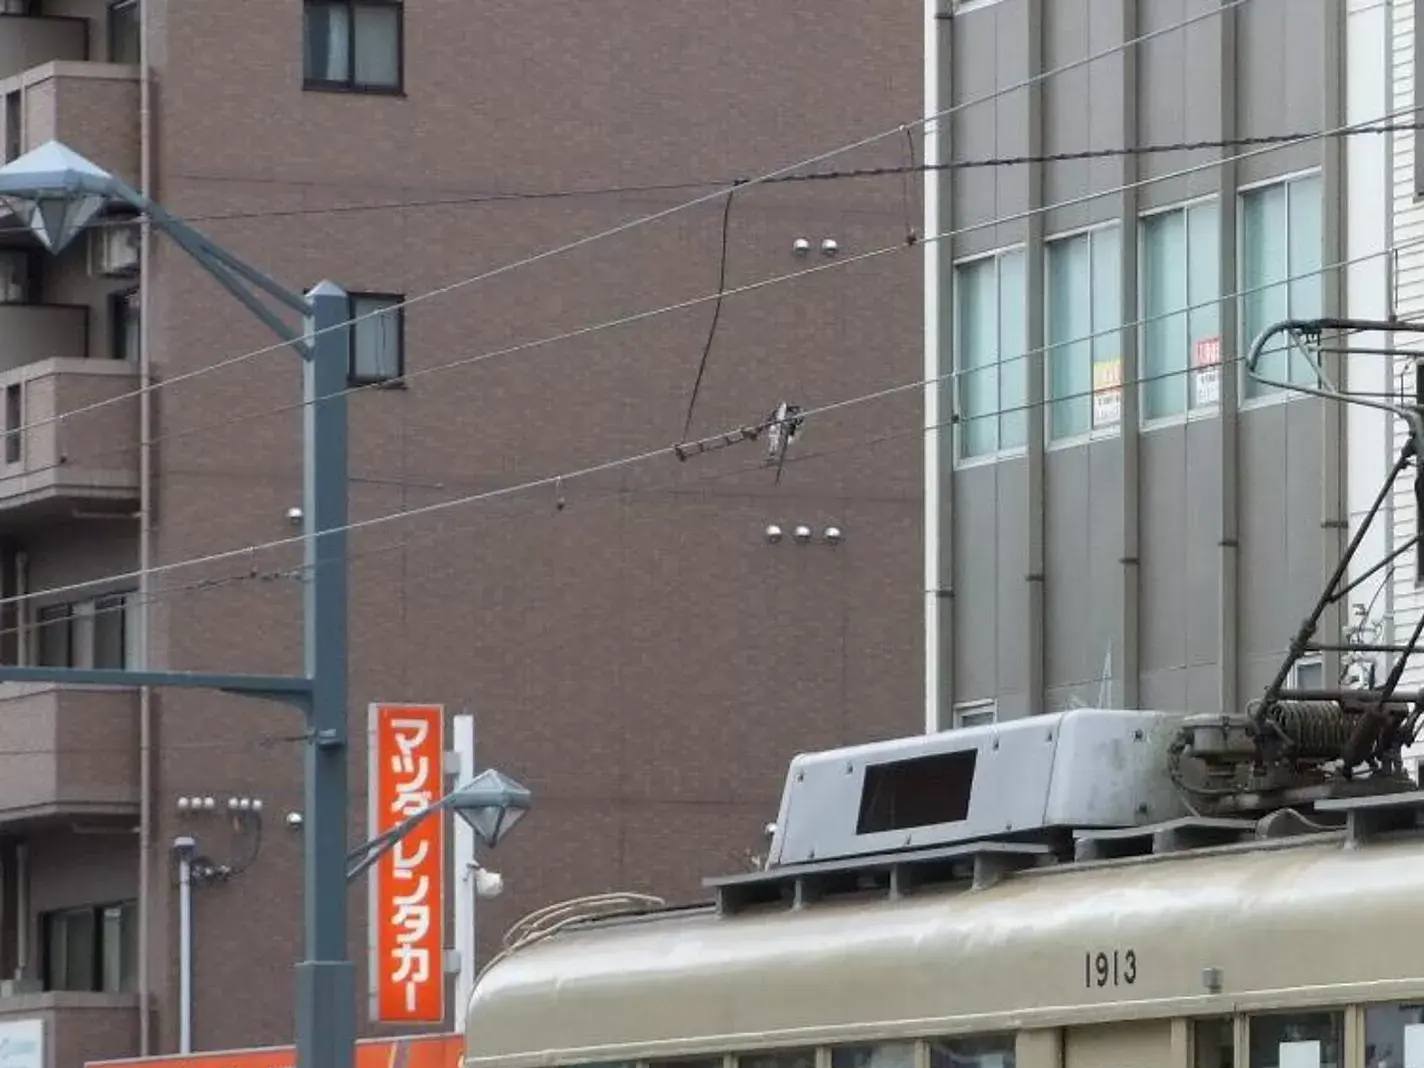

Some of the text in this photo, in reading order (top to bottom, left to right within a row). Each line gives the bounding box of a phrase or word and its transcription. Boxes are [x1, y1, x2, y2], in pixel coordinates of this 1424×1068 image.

[391, 718, 429, 1012] マツダレンタカー
[1085, 949, 1137, 988] 1913
